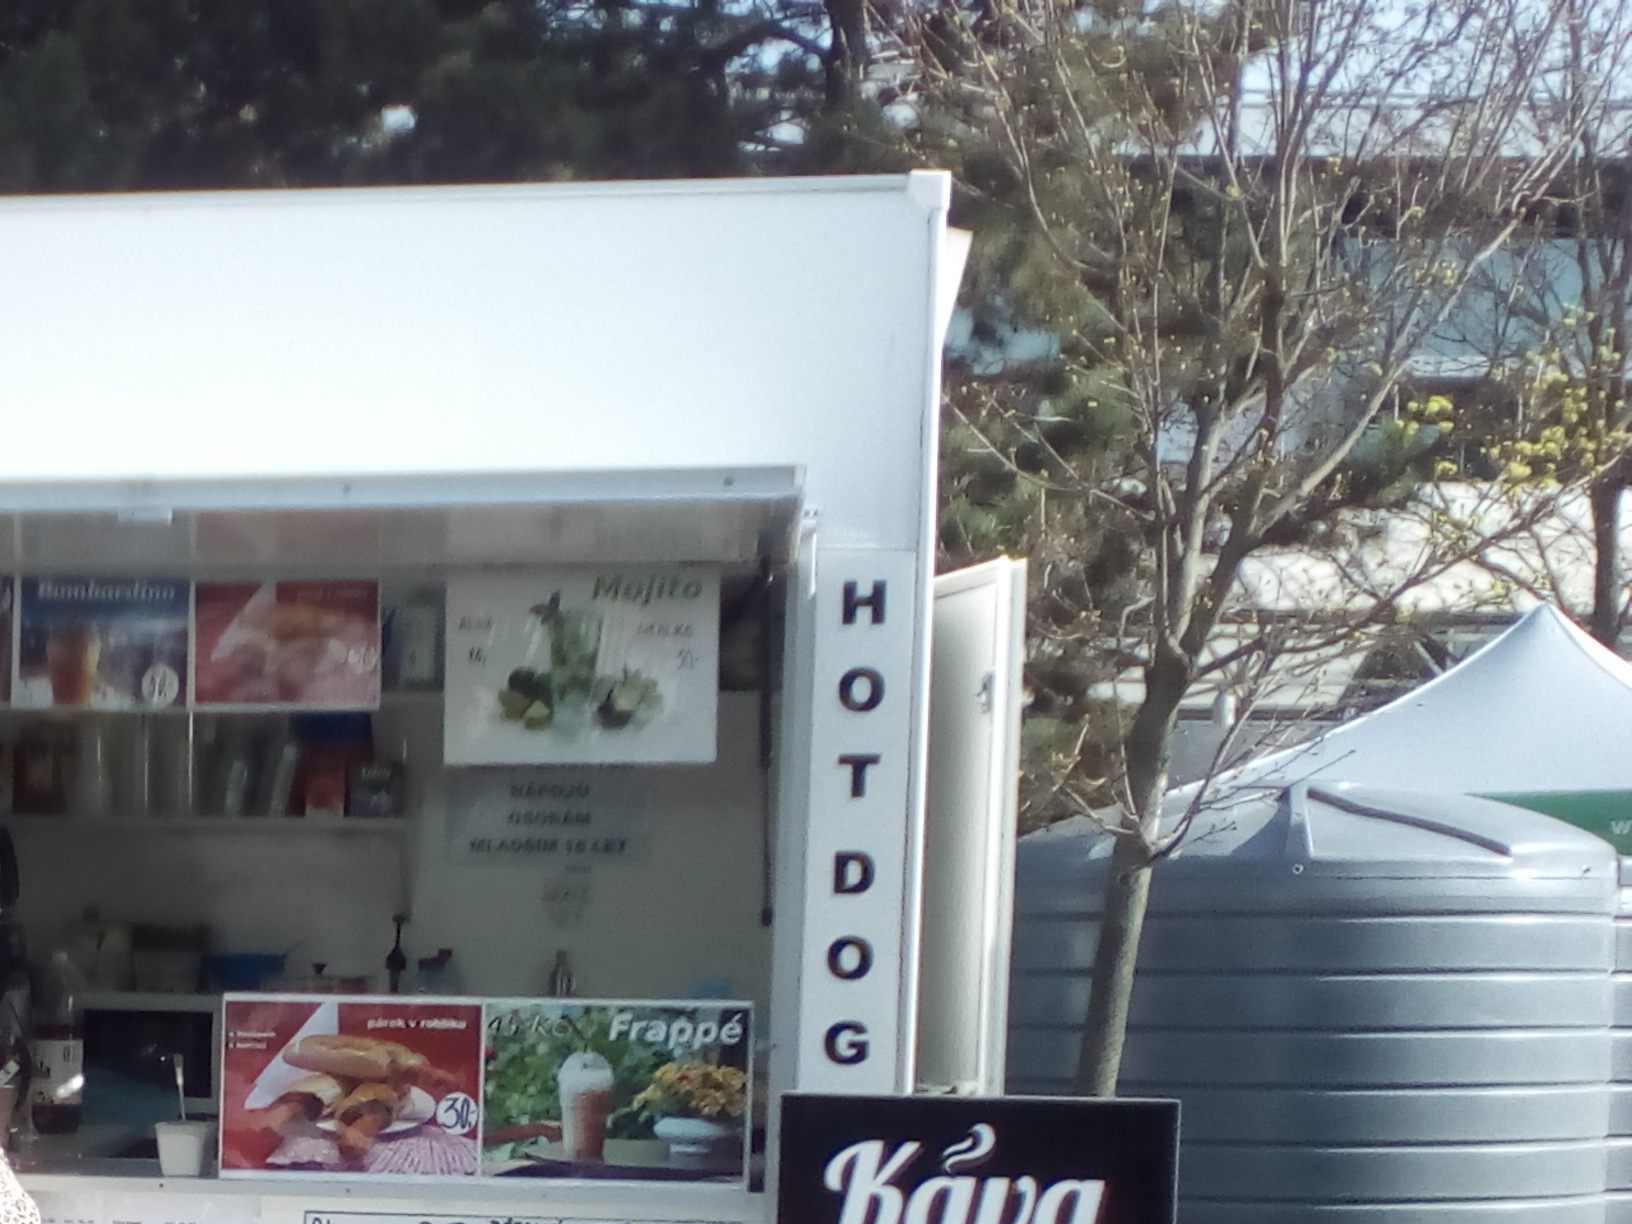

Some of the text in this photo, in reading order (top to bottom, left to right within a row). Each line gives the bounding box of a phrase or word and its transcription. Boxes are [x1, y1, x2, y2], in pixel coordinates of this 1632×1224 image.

[824, 579, 888, 1066] HOT DOG
[609, 1011, 744, 1050] Frappé
